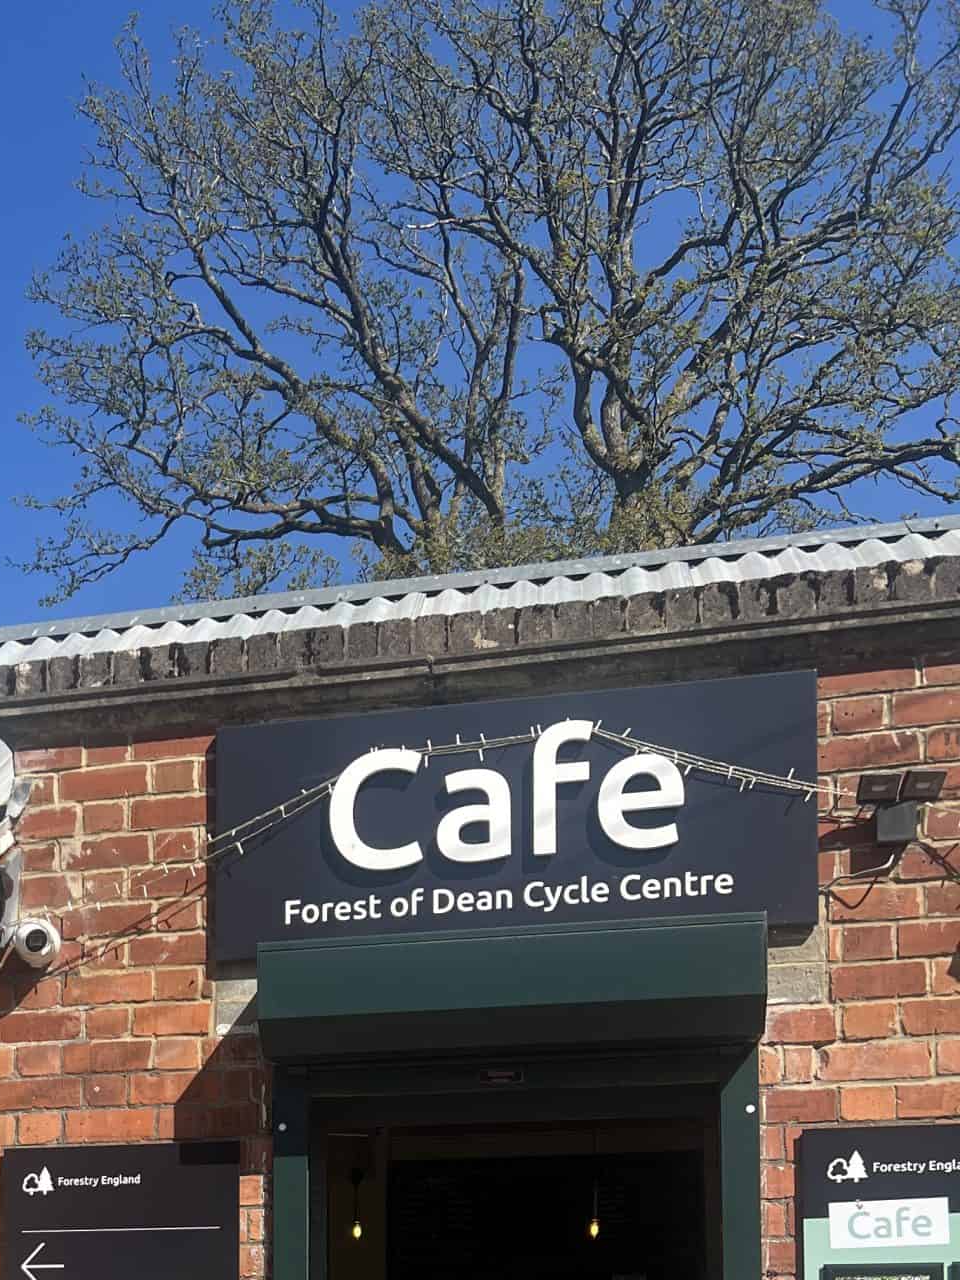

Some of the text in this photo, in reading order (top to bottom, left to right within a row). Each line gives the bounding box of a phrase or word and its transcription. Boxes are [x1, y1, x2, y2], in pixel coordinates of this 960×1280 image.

[328, 719, 686, 871] Cafe
[285, 872, 733, 924] Forest of Dean Cycle Centre
[58, 1175, 140, 1187] Forestry England
[873, 1162, 925, 1173] Forestry
[847, 1206, 933, 1239] Cafe
